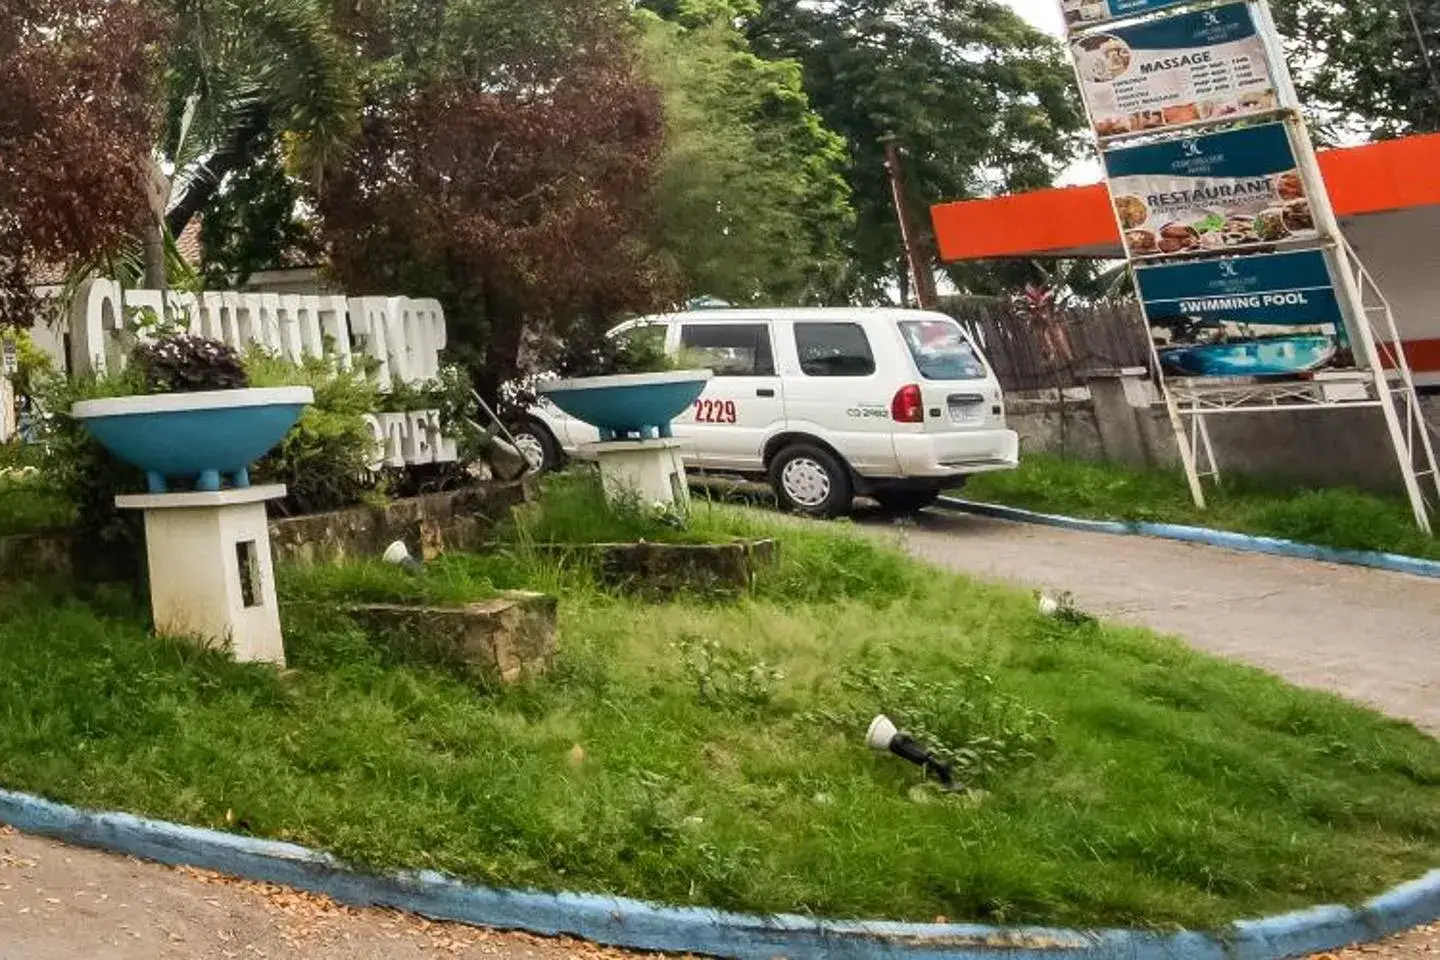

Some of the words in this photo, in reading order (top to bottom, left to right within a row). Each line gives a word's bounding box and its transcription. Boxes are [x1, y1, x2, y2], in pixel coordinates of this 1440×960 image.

[1140, 51, 1212, 73] MASSAGE
[1147, 178, 1273, 207] RESTAURANT
[1179, 296, 1260, 313] SWIMMING
[1263, 292, 1308, 307] POOL
[694, 399, 736, 423] 2229
[360, 408, 458, 471] OTEL
